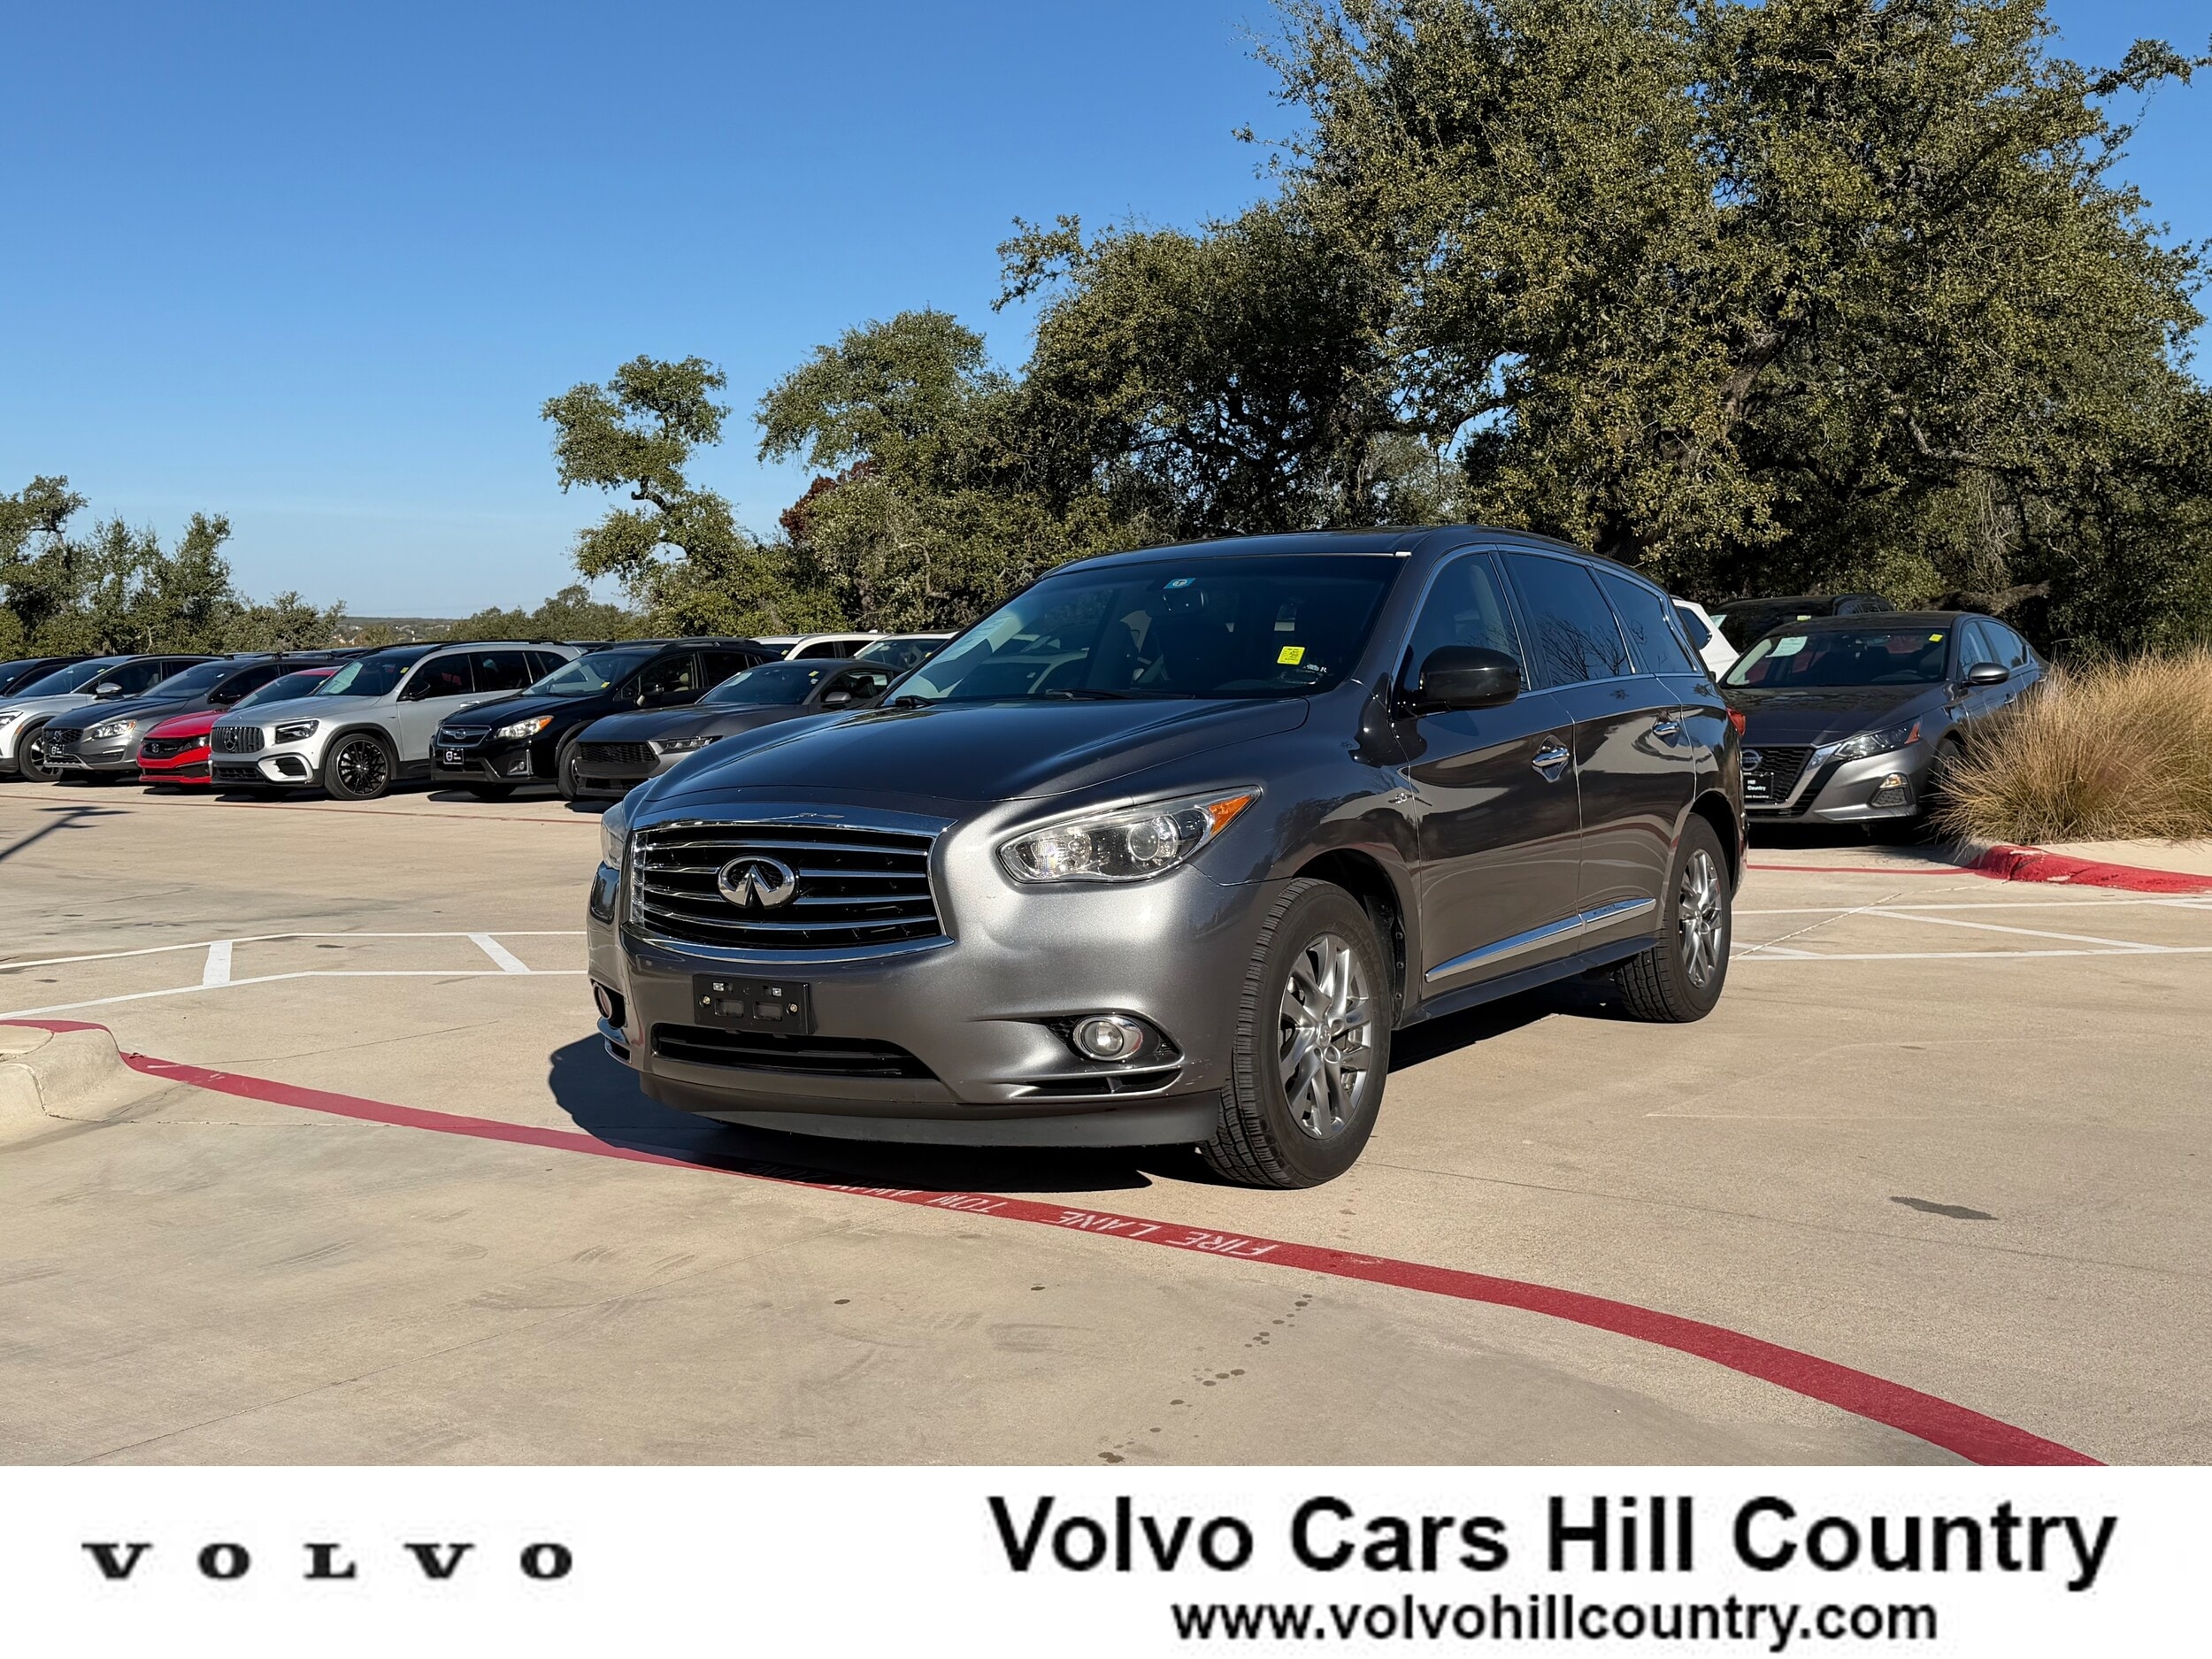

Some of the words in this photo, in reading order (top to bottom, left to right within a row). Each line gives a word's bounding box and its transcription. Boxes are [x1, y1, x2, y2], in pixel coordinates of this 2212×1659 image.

[926, 1194, 1008, 1213] TOW
[1040, 1210, 1162, 1237] LANE
[1165, 1231, 1279, 1256] FIRE
